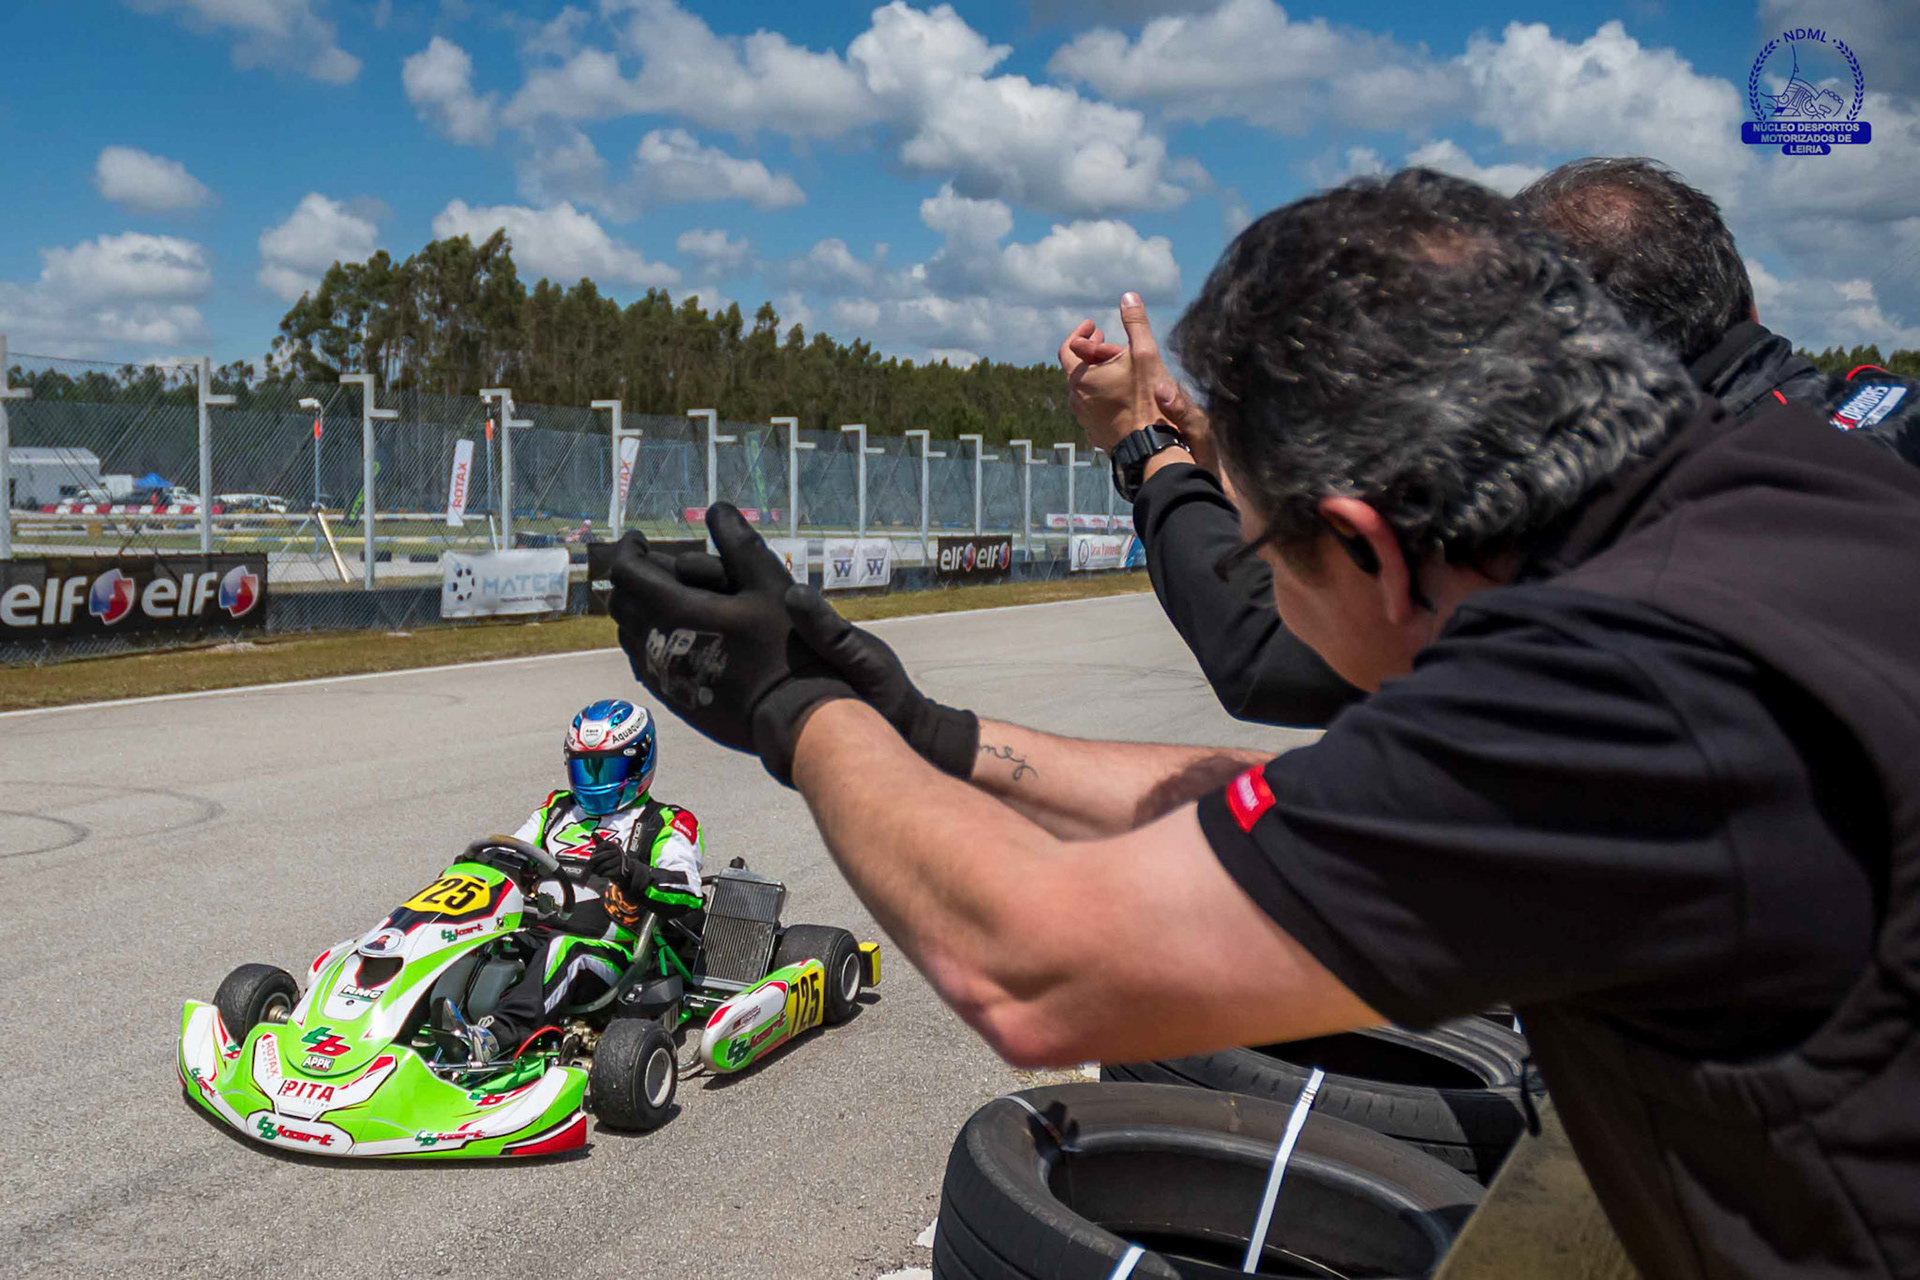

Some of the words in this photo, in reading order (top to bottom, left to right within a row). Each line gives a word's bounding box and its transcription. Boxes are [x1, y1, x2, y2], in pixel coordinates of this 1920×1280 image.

[452, 462, 467, 508] ROTAX
[940, 546, 964, 571] elf
[976, 544, 1000, 569] elf
[0, 576, 87, 626] elf
[142, 571, 217, 617] elf
[790, 971, 820, 1037] 725
[266, 1040, 280, 1077] ROTAX
[302, 1056, 331, 1069] APPK
[281, 1080, 335, 1103] PITA
